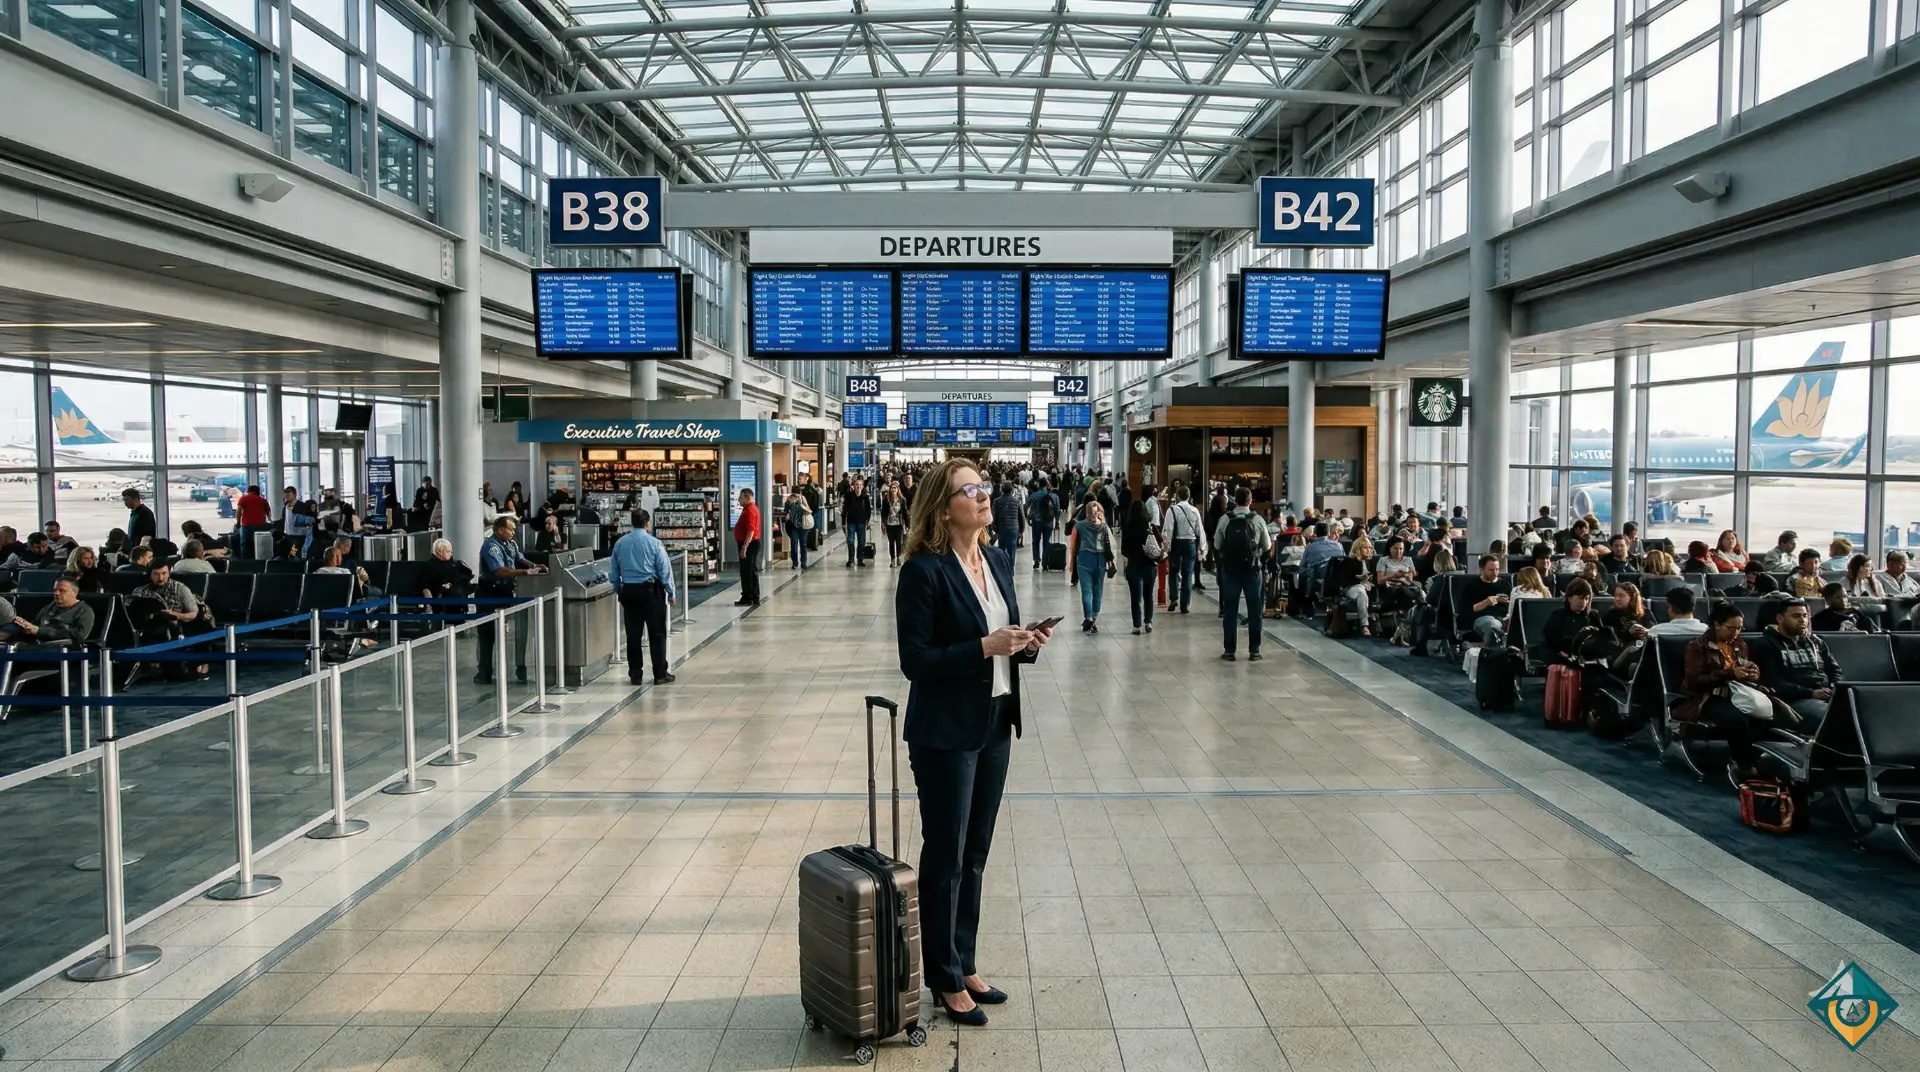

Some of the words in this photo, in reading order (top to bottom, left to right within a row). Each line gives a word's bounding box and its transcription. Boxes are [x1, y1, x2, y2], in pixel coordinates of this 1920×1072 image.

[563, 191, 650, 231] B38
[1274, 191, 1361, 231] B42
[880, 236, 1041, 257] DEPARTURES
[850, 380, 878, 392] B48
[1057, 380, 1084, 392] B42
[941, 392, 993, 401] DEPARTURES
[564, 423, 633, 439] Executive
[635, 423, 683, 439] Travel
[683, 422, 722, 442] Shop
